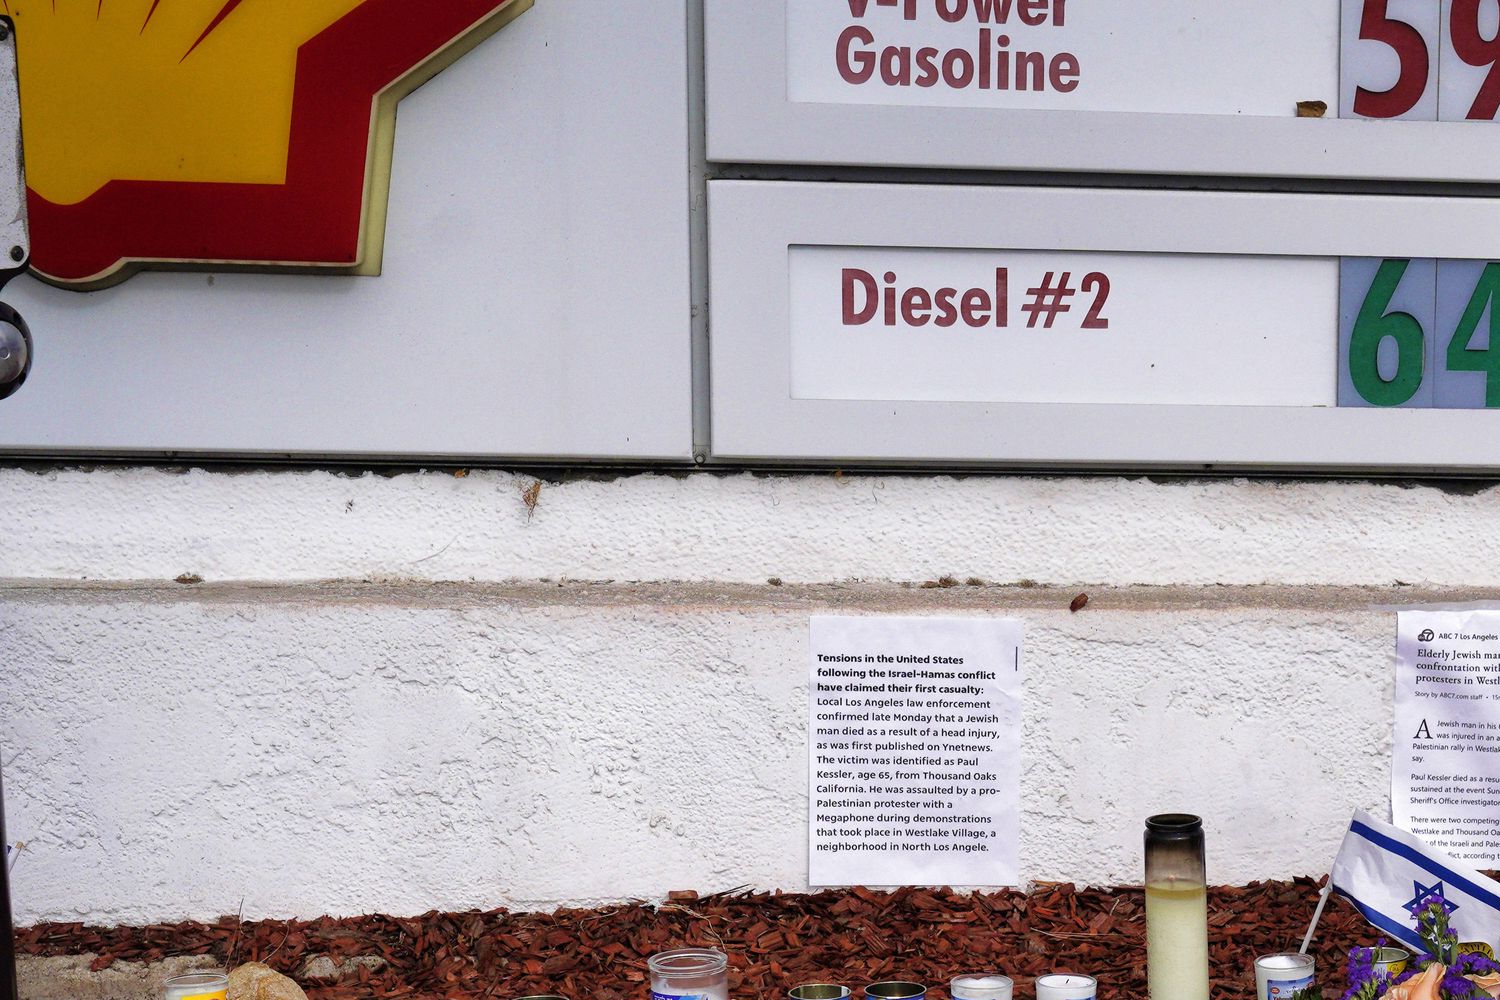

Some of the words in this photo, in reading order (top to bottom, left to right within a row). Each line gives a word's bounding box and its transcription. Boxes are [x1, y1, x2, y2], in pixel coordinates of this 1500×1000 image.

[836, 25, 1081, 93] Gasoline
[842, 267, 1008, 328] Diesel
[1021, 271, 1111, 329] #2
[1471, 633, 1498, 642] Angeles
[817, 653, 862, 662] Tensions
[876, 654, 894, 663] the
[896, 654, 930, 663] United
[932, 655, 963, 664] States
[1416, 648, 1450, 661] Elderly
[1451, 649, 1481, 660] Jewish
[1415, 661, 1480, 671] confrontation
[816, 667, 866, 679] following
[868, 668, 885, 677] the
[888, 669, 955, 678] Israel-Hamas
[957, 670, 995, 679] conflict
[1415, 675, 1461, 684] protesters
[817, 682, 842, 691] have
[844, 683, 885, 692] claimed
[887, 683, 912, 692] their
[914, 683, 936, 693] first
[938, 684, 983, 695] casualty:
[817, 697, 842, 706] Local
[845, 698, 861, 706] Los
[864, 698, 903, 708] Angeles
[906, 698, 923, 707] law
[925, 698, 990, 708] enforcement
[816, 711, 869, 721] confirmed
[871, 712, 890, 721] late
[893, 713, 932, 724] Monday
[934, 713, 955, 722] that
[965, 714, 998, 723] Jewish
[841, 726, 864, 735] died
[888, 727, 917, 736] result
[919, 727, 930, 736] of
[941, 728, 965, 737] head
[968, 730, 999, 739] injury,
[1413, 718, 1433, 740] A
[1478, 721, 1485, 729] in
[1451, 732, 1476, 741] injured
[851, 740, 872, 750] first
[875, 741, 924, 752] published
[942, 743, 992, 752] Ynetnews.
[1412, 742, 1448, 750] Palestinian
[1450, 743, 1465, 752] rally
[816, 755, 835, 764] The
[837, 755, 868, 764] victim
[892, 756, 941, 765] identified
[957, 757, 978, 766] Paul
[1411, 755, 1424, 763] say.
[816, 769, 854, 780] Kessler,
[857, 771, 876, 780] age
[878, 771, 892, 780] 65,
[895, 770, 920, 779] from
[922, 771, 971, 780] Thousand
[973, 772, 996, 780] Oaks
[816, 783, 866, 793] California.
[869, 785, 882, 793] He
[906, 785, 953, 794] assaulted
[956, 785, 968, 796] by
[979, 788, 1000, 796] pro-
[816, 798, 871, 807] Palestinian
[873, 800, 920, 809] protester
[922, 799, 944, 808] with
[816, 813, 874, 824] Megaphone
[876, 813, 910, 824] during
[912, 813, 991, 823] demonstrations
[816, 827, 837, 836] that
[839, 827, 861, 836] took
[864, 827, 890, 838] place
[892, 827, 902, 836] in
[904, 828, 949, 837] Westlake
[951, 828, 988, 839] Village,
[816, 841, 887, 852] neighborhood
[890, 841, 899, 850] in
[901, 842, 930, 851] North
[933, 843, 949, 851] Los
[951, 842, 988, 853] Angele.
